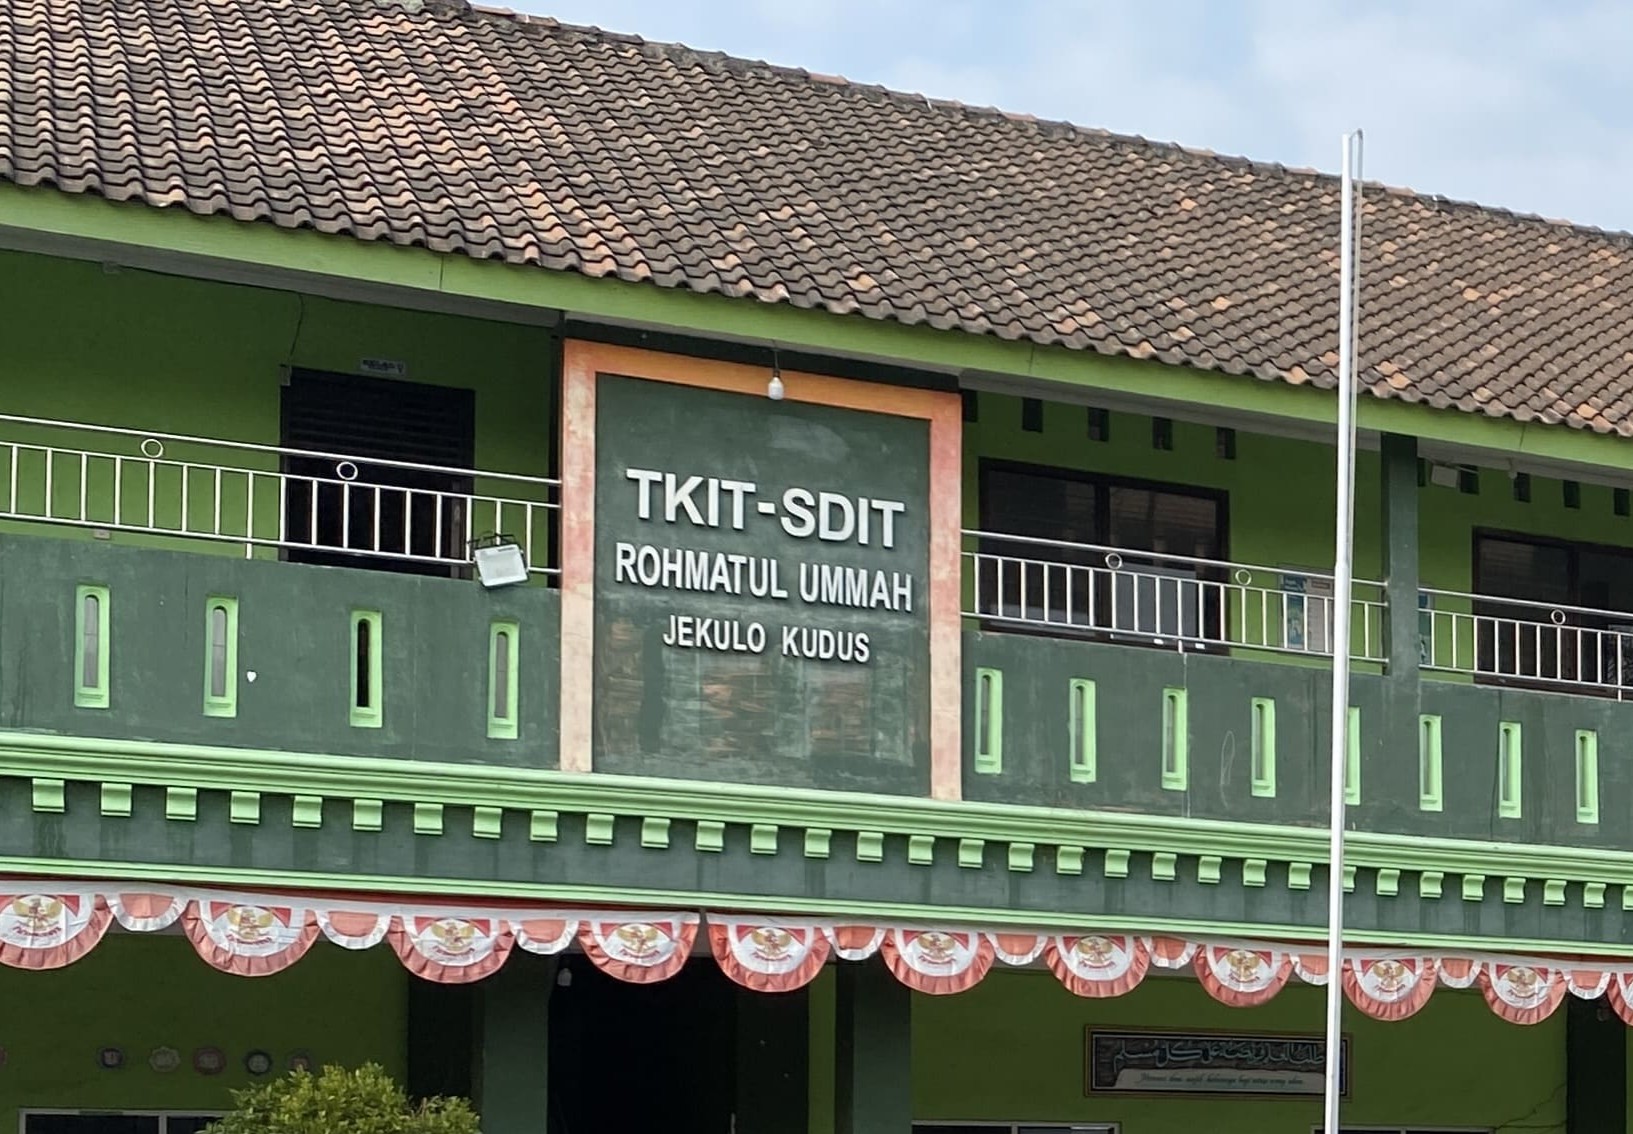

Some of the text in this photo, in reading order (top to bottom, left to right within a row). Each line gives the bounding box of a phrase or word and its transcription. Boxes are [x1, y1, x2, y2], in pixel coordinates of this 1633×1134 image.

[626, 468, 906, 549] TKIT-SDIT
[614, 541, 913, 613] ROHMATUL UMMAH
[662, 613, 871, 664] JEKULO KUDUS
